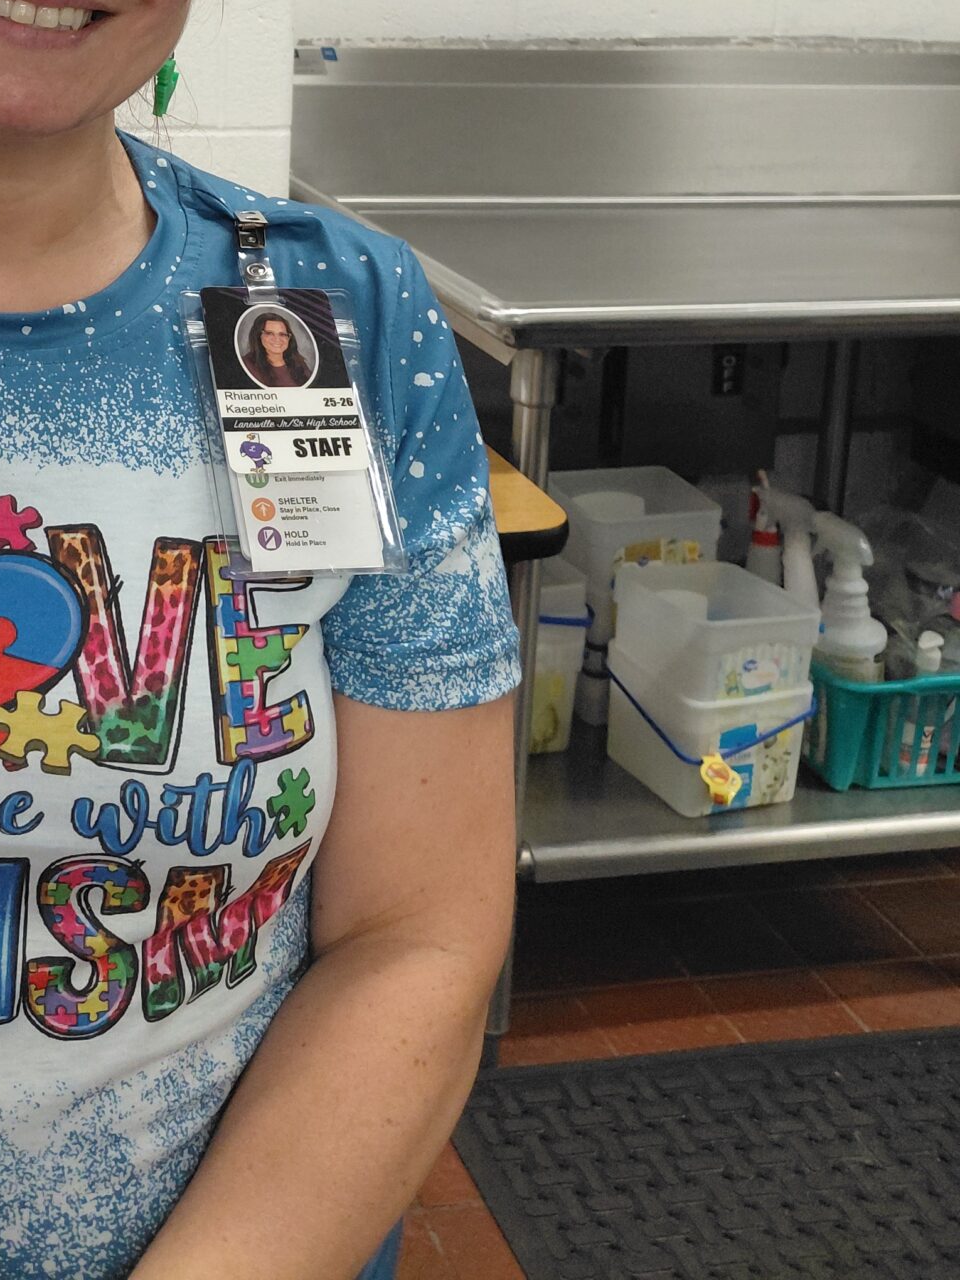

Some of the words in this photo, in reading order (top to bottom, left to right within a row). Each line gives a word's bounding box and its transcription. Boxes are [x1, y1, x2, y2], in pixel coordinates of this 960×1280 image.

[225, 391, 278, 401] Rhiannon
[323, 397, 354, 407] 25-26
[226, 404, 286, 415] Kaegebein
[233, 419, 275, 429] Lanesville
[306, 418, 327, 430] High
[328, 417, 358, 427] School
[292, 437, 353, 458] STAFF
[278, 497, 318, 505] SHELTER
[71, 757, 286, 860] with
